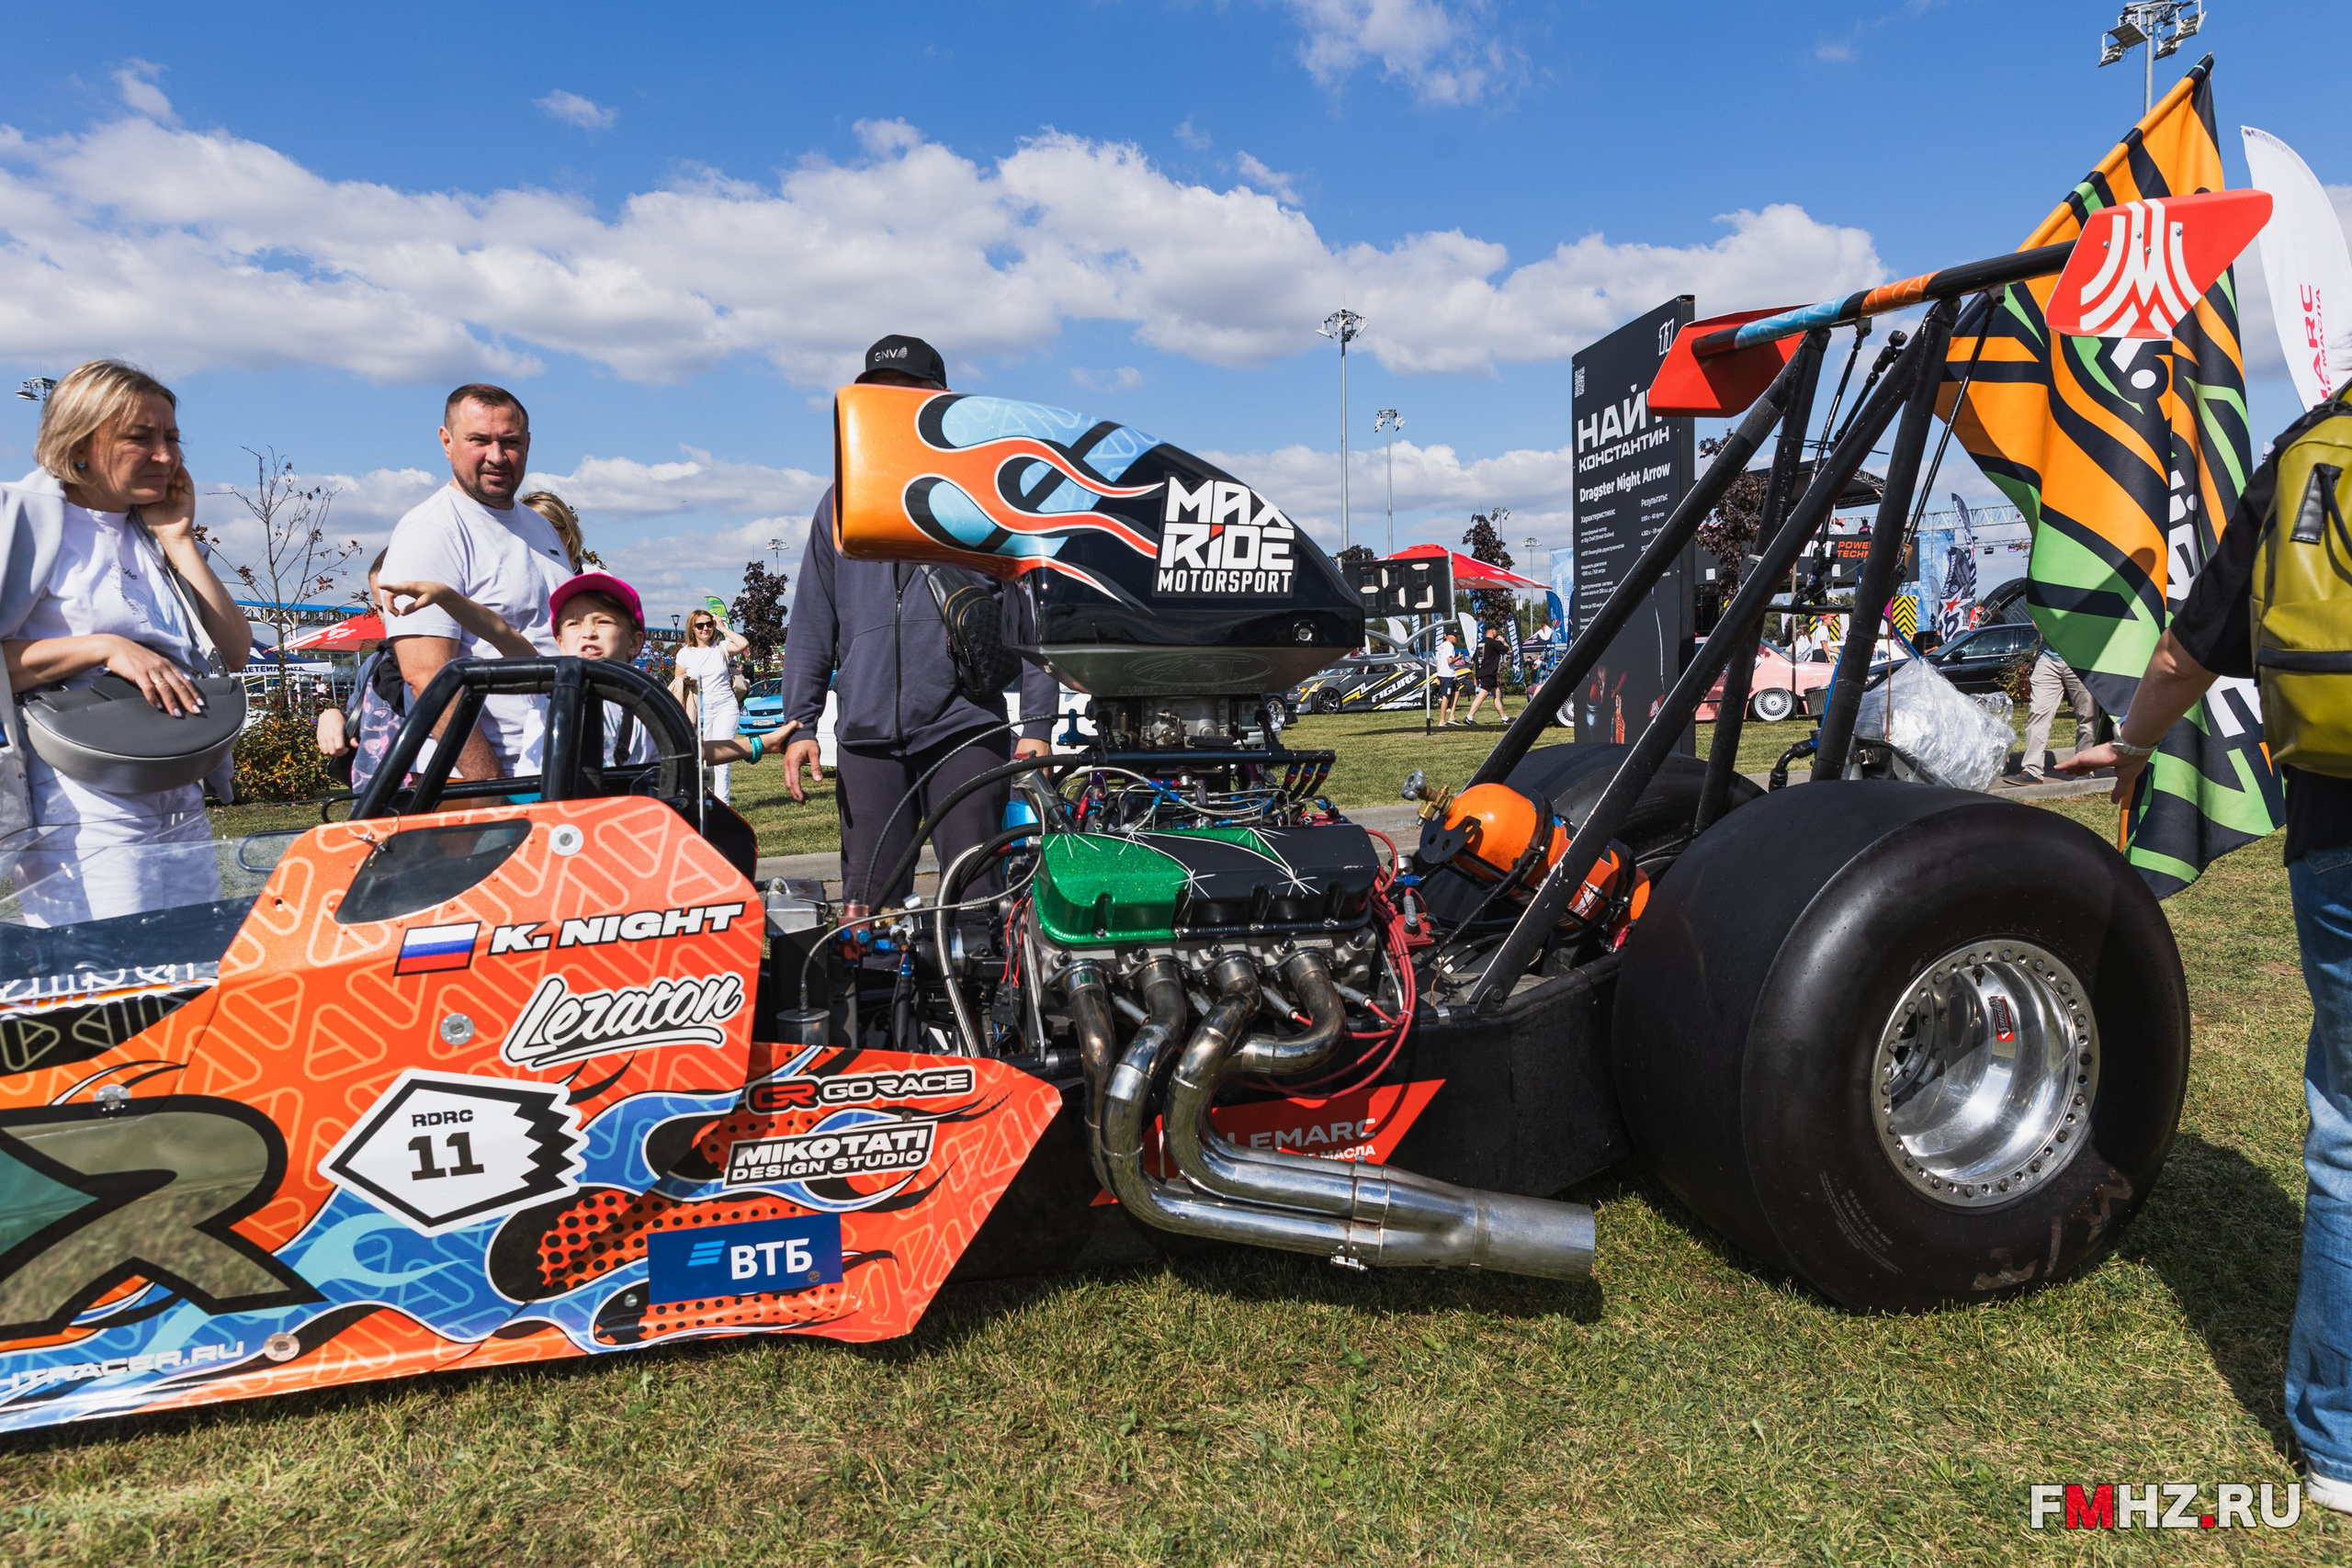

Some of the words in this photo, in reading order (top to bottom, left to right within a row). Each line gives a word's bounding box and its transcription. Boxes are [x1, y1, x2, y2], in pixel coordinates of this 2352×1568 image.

[875, 349, 898, 362] GNV
[1658, 318, 1675, 355] 11
[1577, 383, 1663, 454] НАЙ
[1578, 425, 1670, 473] КОНСТАНТИН
[1579, 480, 1615, 502] Dragster
[1617, 471, 1641, 492] Night
[1642, 462, 1670, 484] Arrow
[1165, 476, 1294, 529] MAX
[1838, 540, 1871, 549] POWE
[1157, 569, 1292, 592] MOTORSPORT
[1372, 671, 1418, 703] FIGURE
[490, 922, 551, 954] K.
[558, 901, 744, 947] NIGHT
[823, 1073, 968, 1100] GORACE
[411, 1109, 474, 1127] RDRC
[407, 1131, 485, 1181] 11
[731, 1161, 826, 1182] DESIGN
[831, 1149, 922, 1171] STUDIO
[734, 1128, 928, 1168] MIKOTATI
[729, 1237, 814, 1280] ВТБ
